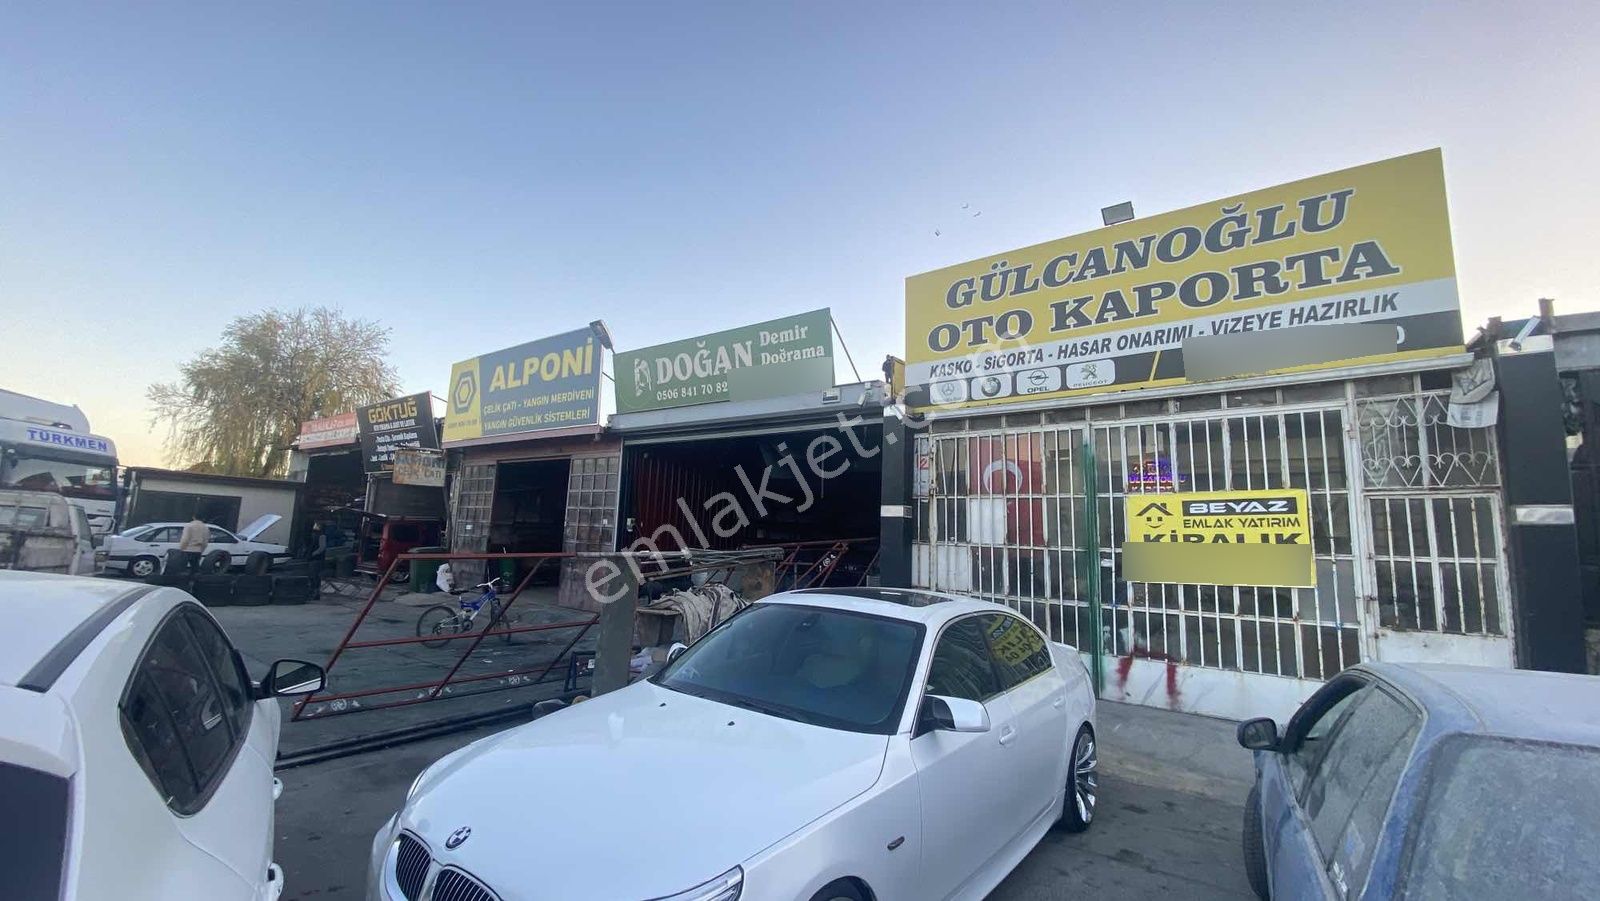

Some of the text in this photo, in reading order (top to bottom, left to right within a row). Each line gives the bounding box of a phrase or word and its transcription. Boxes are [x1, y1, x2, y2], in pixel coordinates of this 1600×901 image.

[946, 188, 1354, 309] GÜLCANOĞLU
[927, 240, 1400, 352] OTO KAPORTA
[759, 325, 809, 346] Demir
[930, 360, 972, 378] KASKO
[1057, 337, 1112, 360] HASAR
[1116, 325, 1193, 350] ONARIMI
[1289, 292, 1400, 325] HAZIRLIK
[489, 337, 594, 392] ALPONİ
[655, 341, 825, 384] DOĞAN Doğrama
[484, 403, 500, 416] ÇELİK
[503, 402, 517, 413] ÇATI
[523, 396, 549, 408] YANGIN
[551, 387, 595, 403] MERDİVENİ
[657, 381, 728, 401] 0506 841 70 82
[368, 398, 417, 423] GÖKTUĞ
[484, 420, 506, 431] YANGIN
[508, 414, 542, 428] GÜVENLİK
[544, 407, 590, 423] SİSTEMLERİ
[1189, 500, 1289, 514] BEYAZ
[1183, 516, 1301, 529] EMLAK YATIRIM
